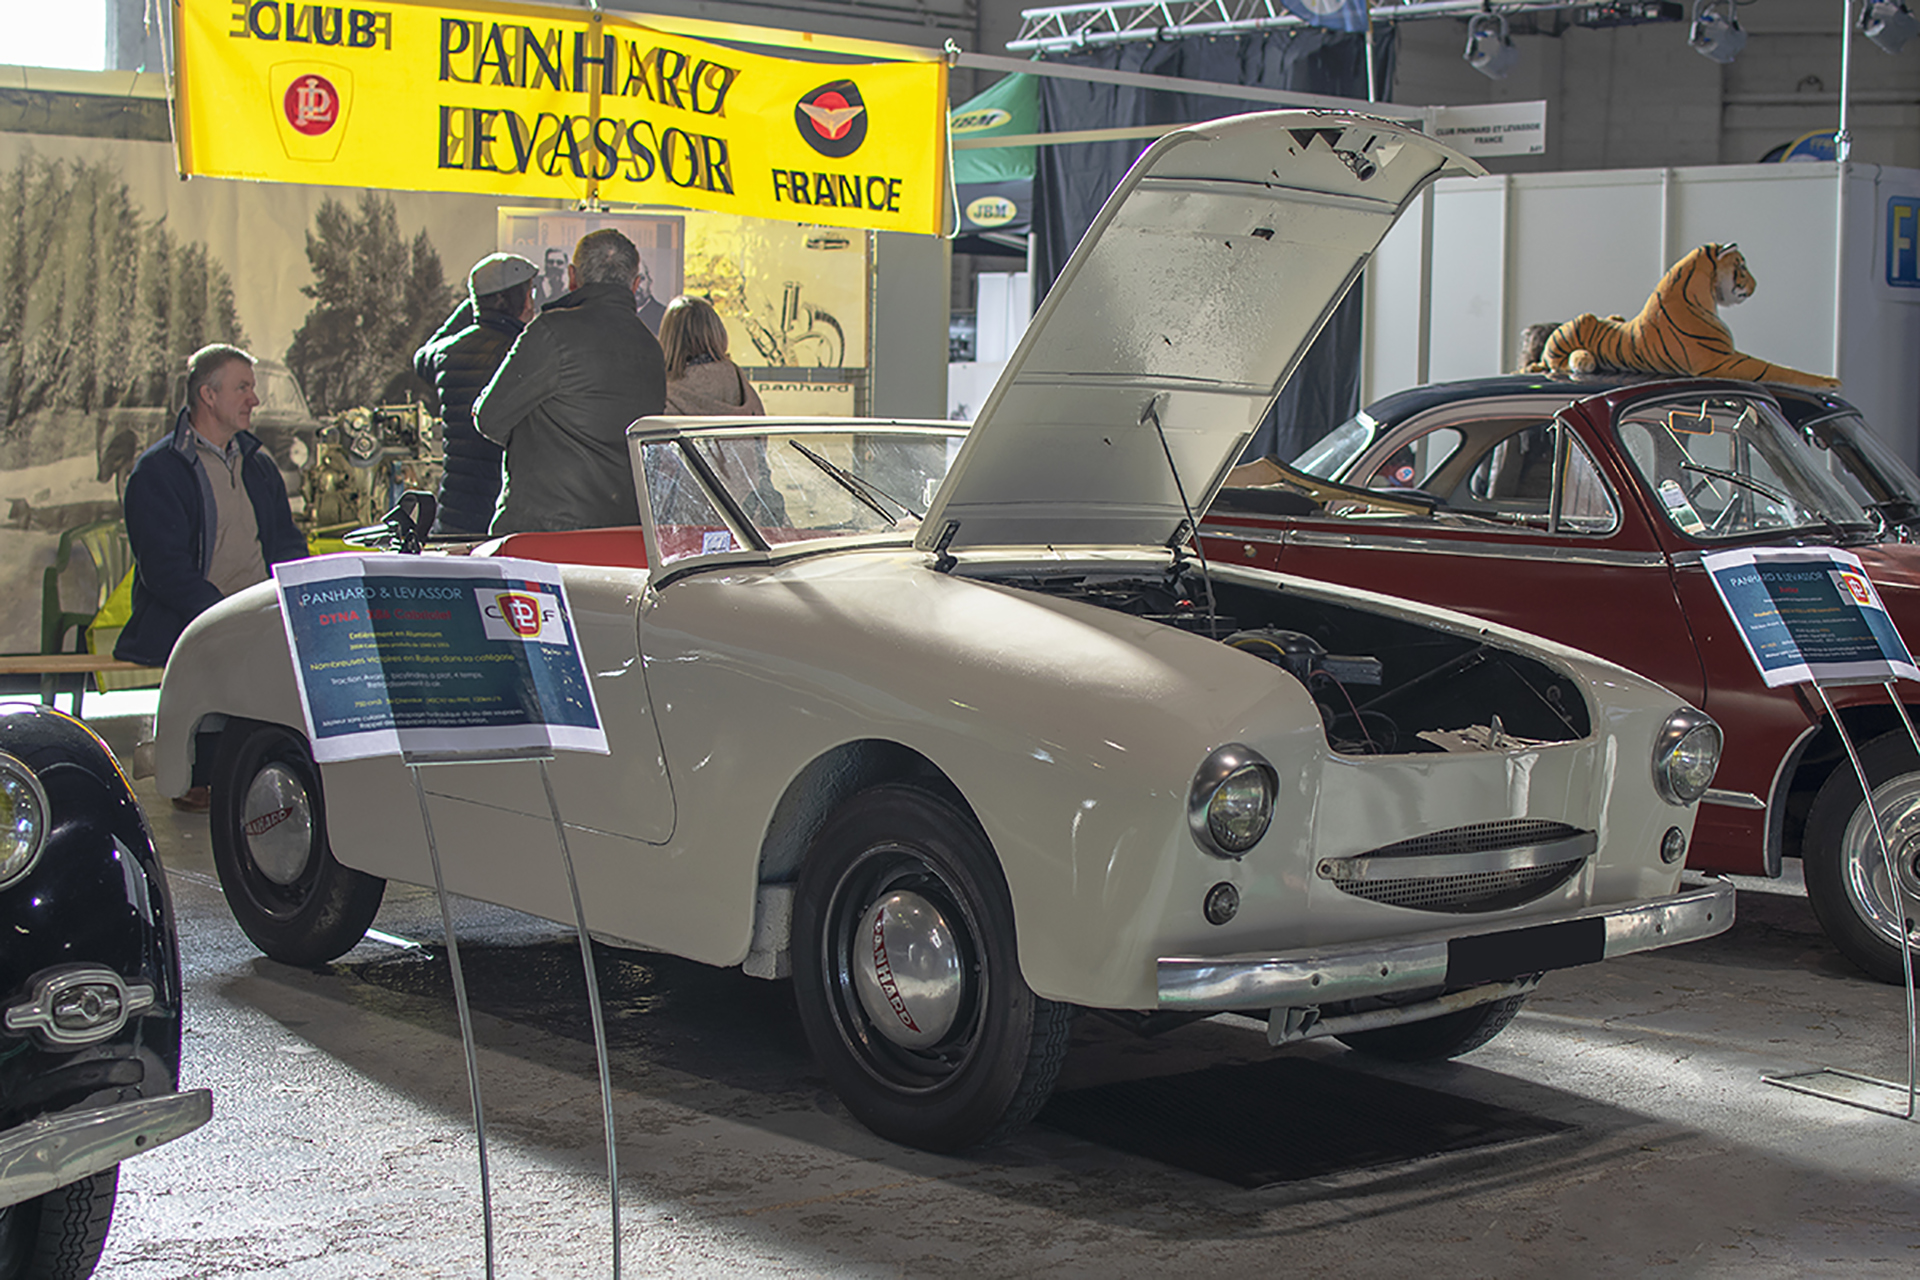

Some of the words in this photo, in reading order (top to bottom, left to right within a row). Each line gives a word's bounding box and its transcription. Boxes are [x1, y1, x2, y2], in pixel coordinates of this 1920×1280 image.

[249, 1, 376, 48] CLUB
[439, 18, 735, 114] PANHARD
[1435, 128, 1455, 136] CLUB
[1474, 136, 1504, 144] FRANCE
[438, 105, 736, 196] LEVASSOR
[771, 168, 903, 213] FRANCE
[973, 204, 1009, 219] JBM
[759, 383, 849, 393] panhard
[301, 587, 376, 606] PANHARD
[380, 588, 390, 598] &
[393, 587, 463, 600] LEVASSOR
[319, 610, 360, 625] DYNA
[394, 608, 452, 620] Cabriolet
[310, 657, 365, 670] Nombreuses
[415, 654, 440, 663] Rallye
[441, 654, 462, 662] dans
[474, 653, 515, 662] catégorie
[874, 919, 912, 1025] PANHARD
